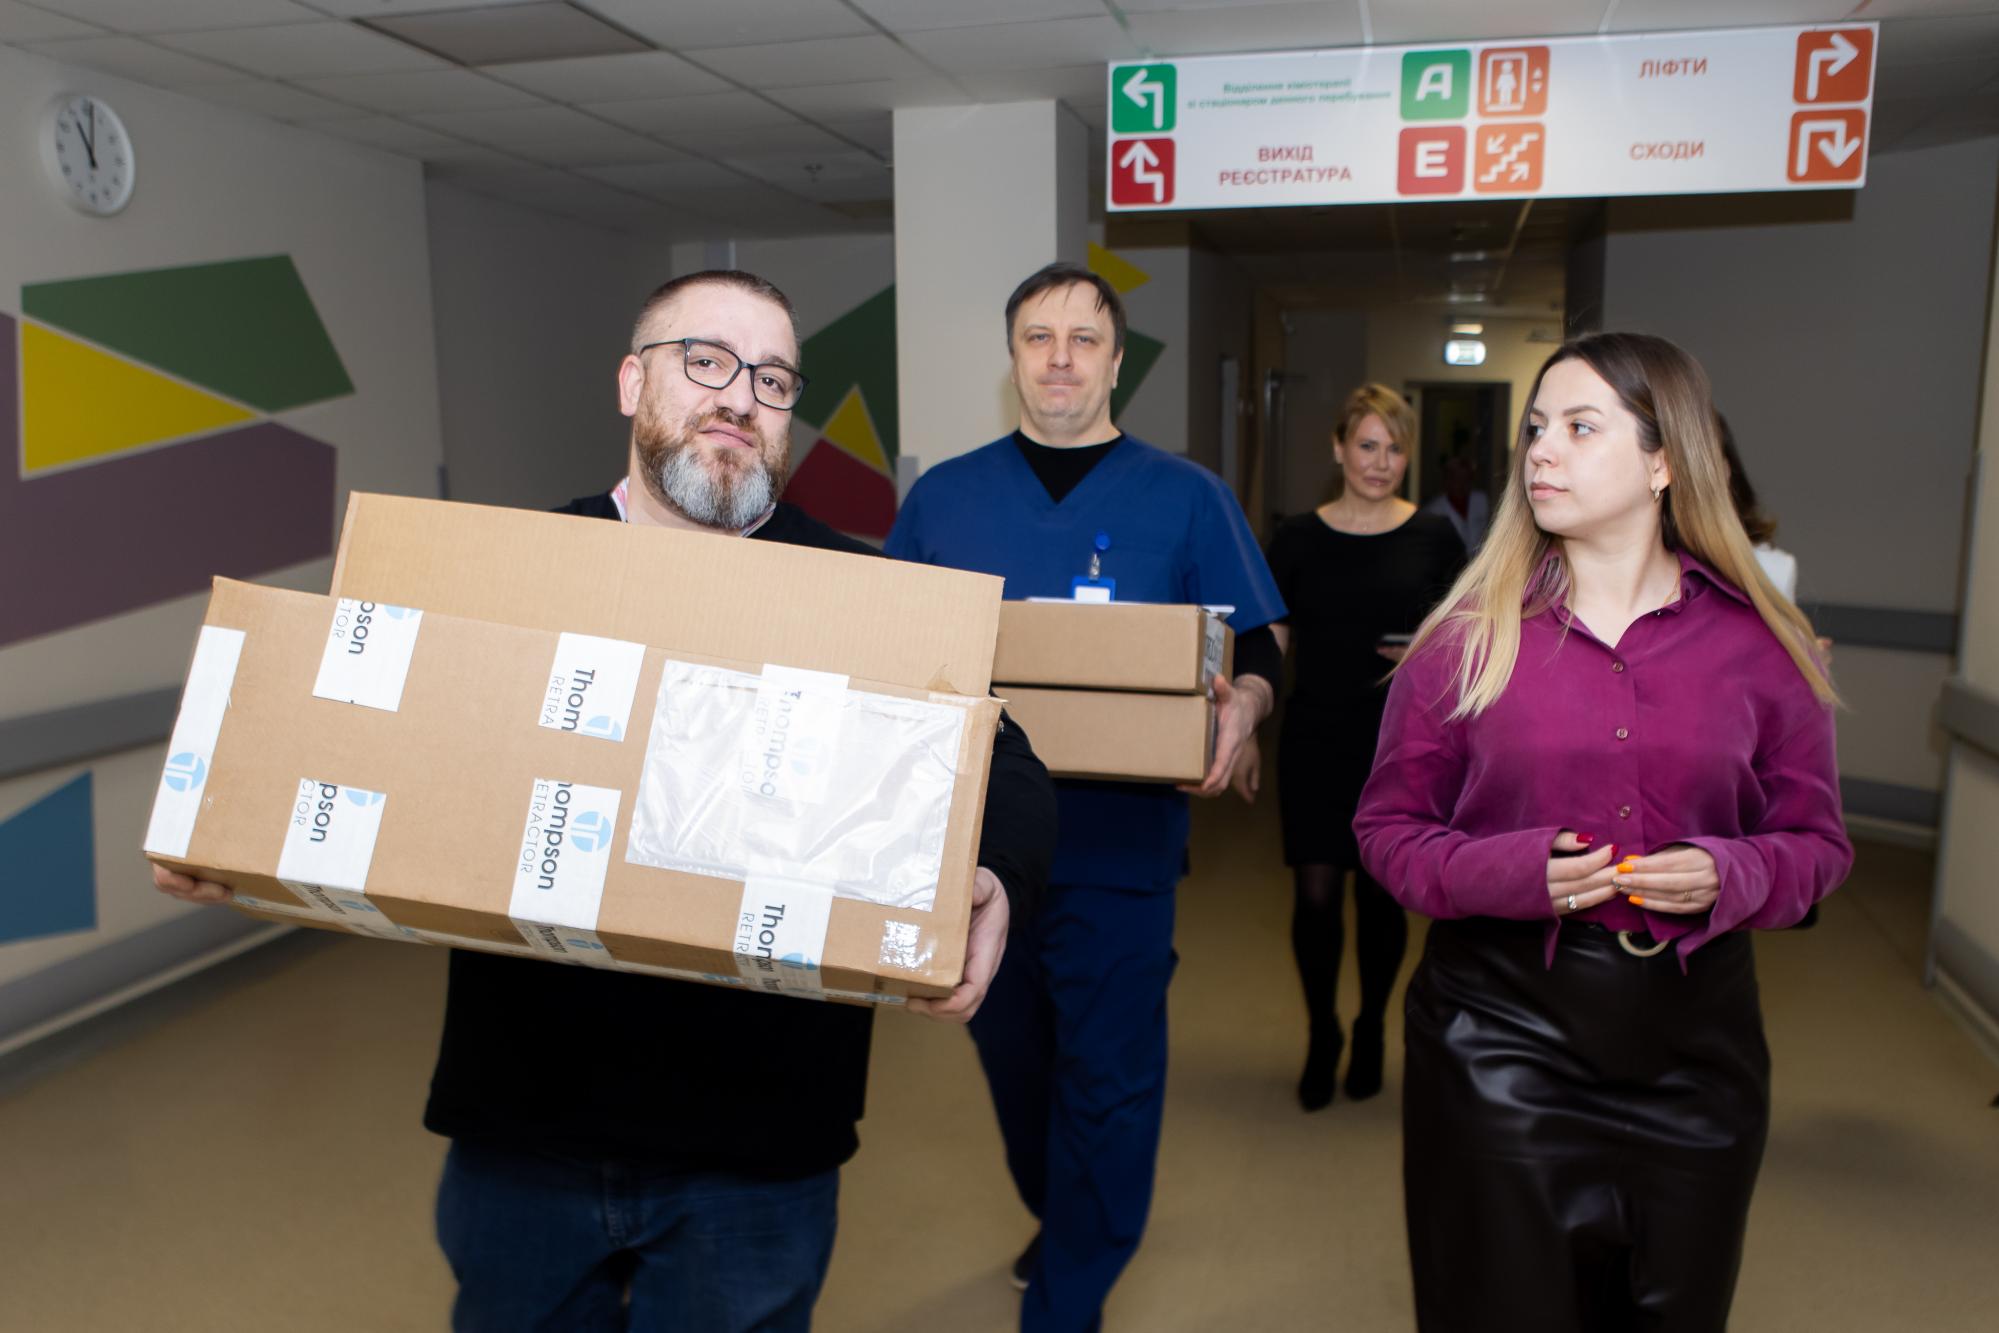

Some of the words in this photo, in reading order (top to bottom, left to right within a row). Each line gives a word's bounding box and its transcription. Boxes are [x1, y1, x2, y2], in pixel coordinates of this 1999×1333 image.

[1639, 58, 1708, 79] ЛІФТИ
[1258, 144, 1314, 162] ВИХІД
[1630, 141, 1705, 161] СХОДИ
[1219, 166, 1352, 186] РЕЄСТРАТУРА
[331, 599, 353, 639] TOR
[541, 676, 565, 725] RETRA
[561, 669, 596, 732] Thom
[310, 783, 338, 842] pson
[520, 780, 550, 874] ETRACTOR
